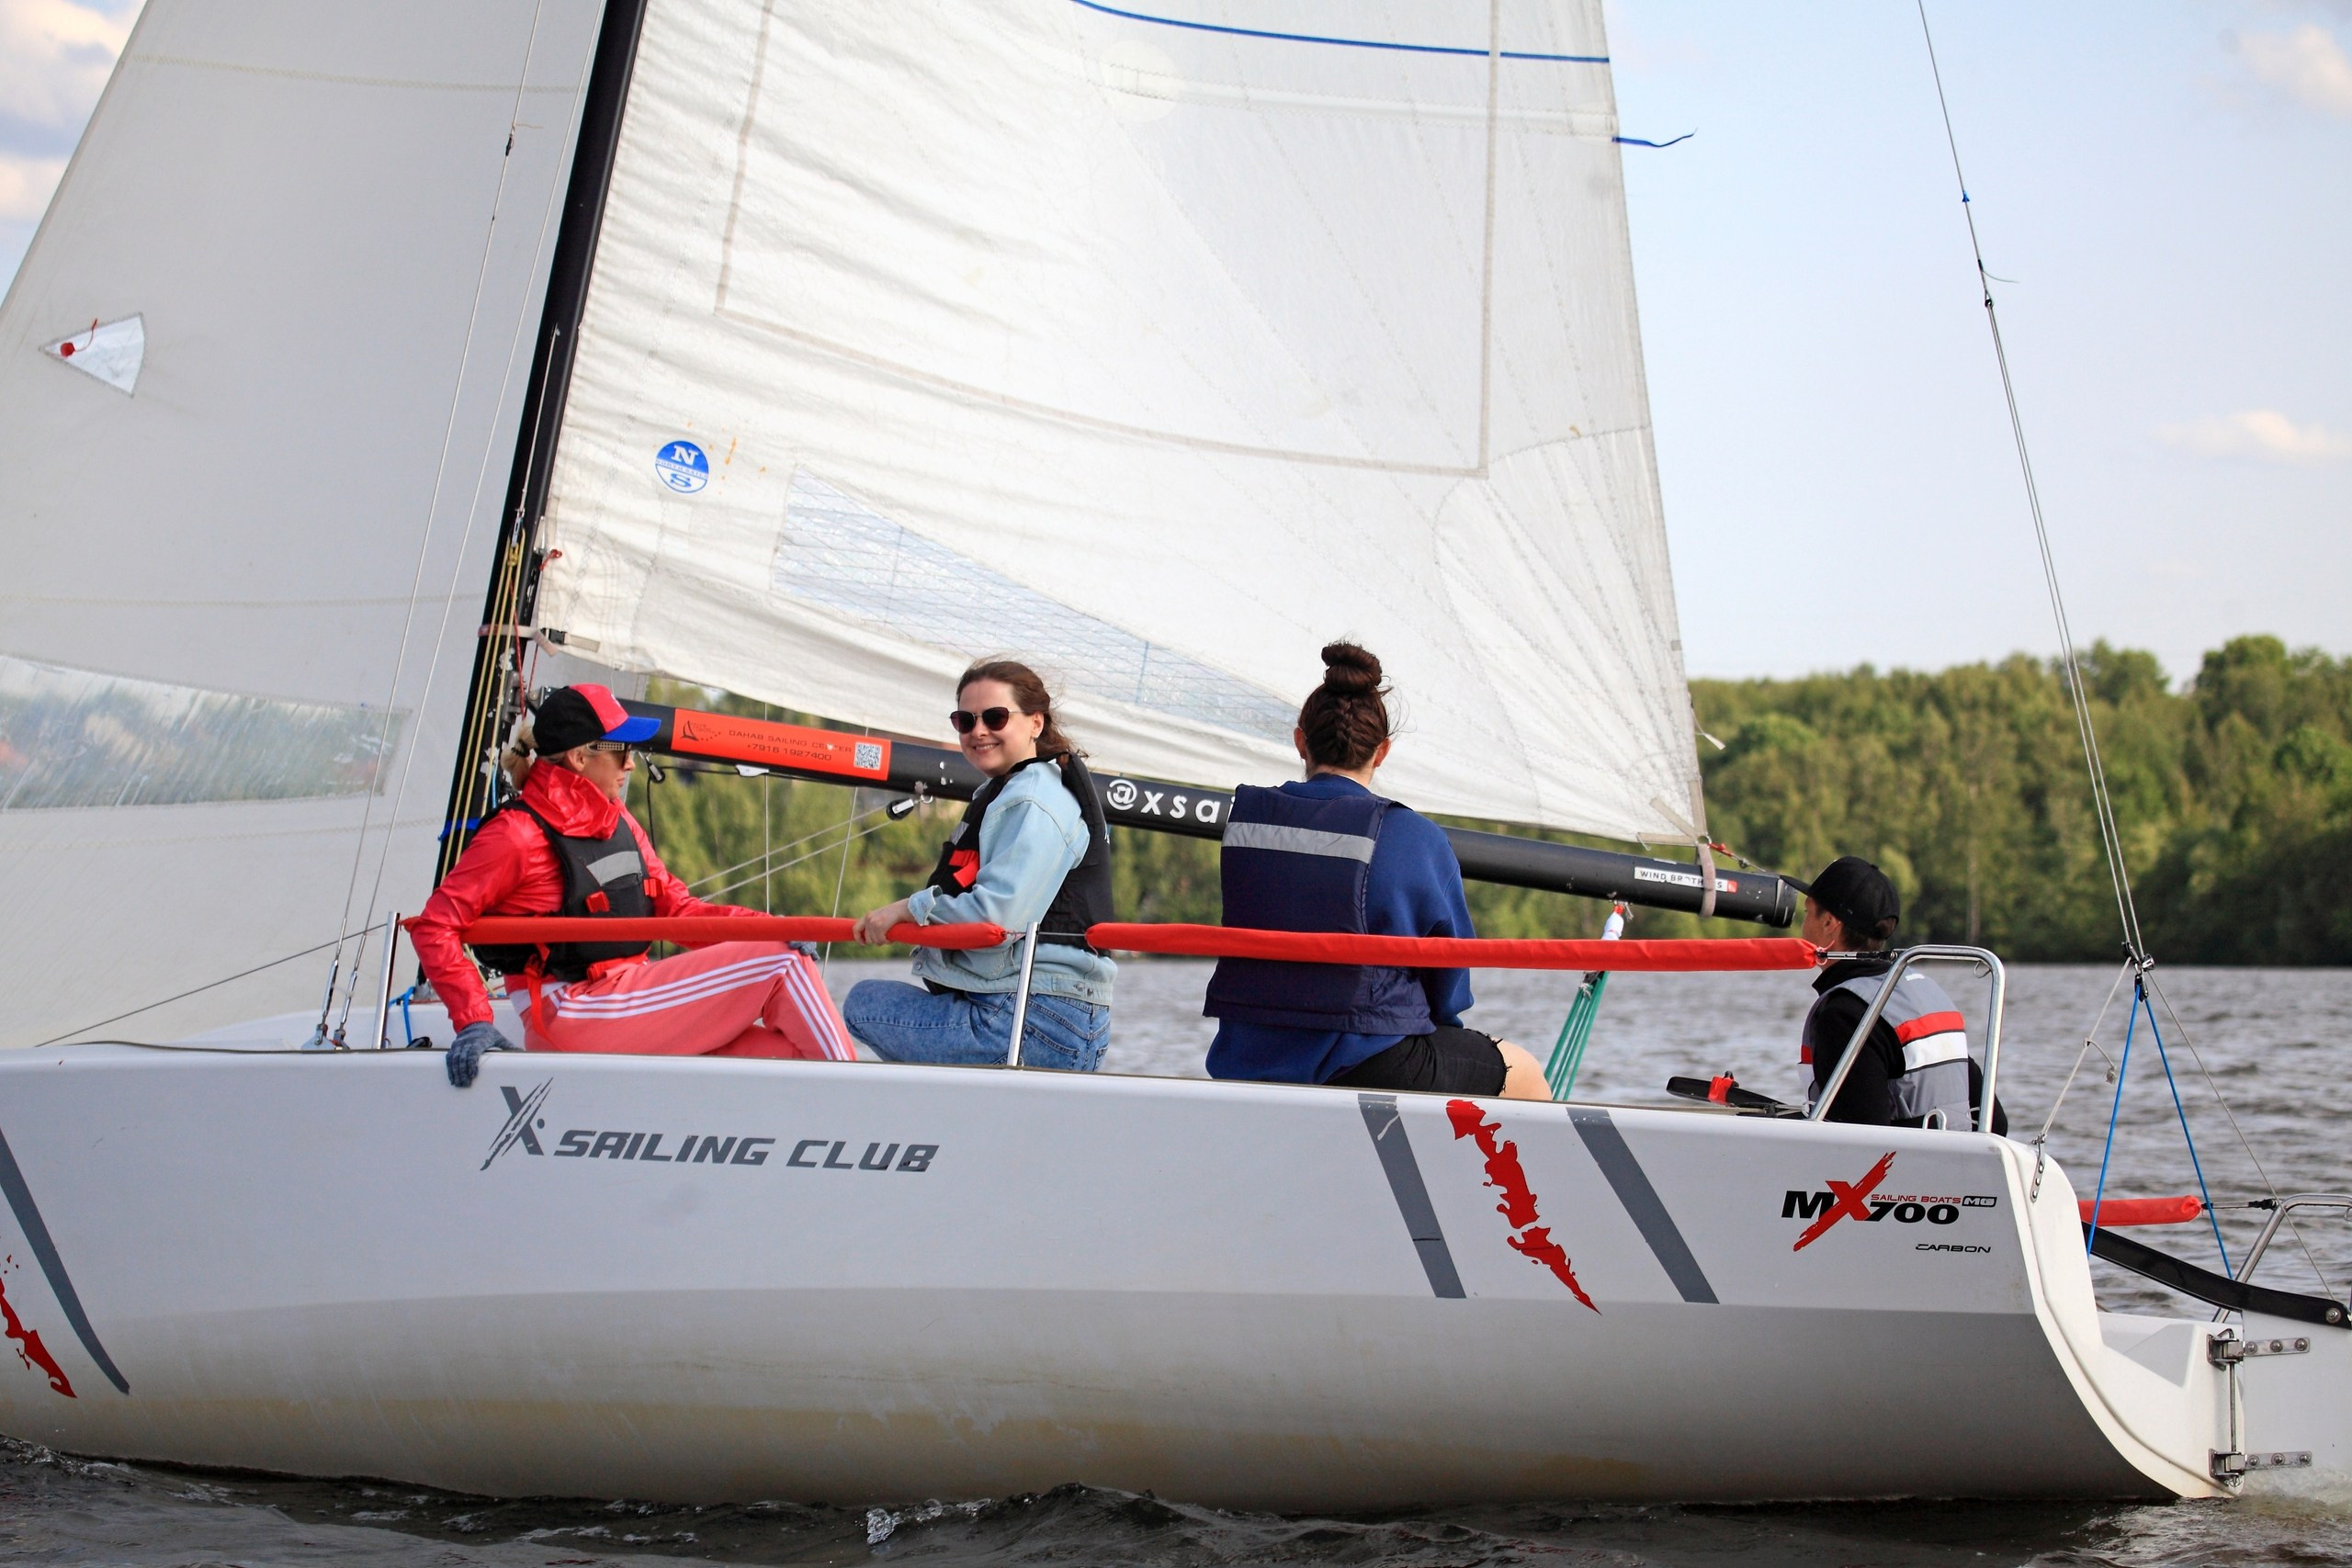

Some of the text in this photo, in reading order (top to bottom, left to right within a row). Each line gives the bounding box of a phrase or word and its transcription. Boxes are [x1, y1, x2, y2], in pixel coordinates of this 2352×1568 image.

[671, 445, 699, 466] N
[670, 473, 692, 488] S
[729, 729, 852, 753] DAHAB SAILING CETER
[783, 748, 831, 761] 1927400
[1640, 870, 1667, 881] WIND
[553, 1129, 775, 1167] SAILING
[786, 1139, 940, 1173] CLUB
[1871, 1194, 1917, 1202] SAILING
[1920, 1196, 1962, 1204] BOATS
[1916, 1244, 1991, 1254] CARBON
